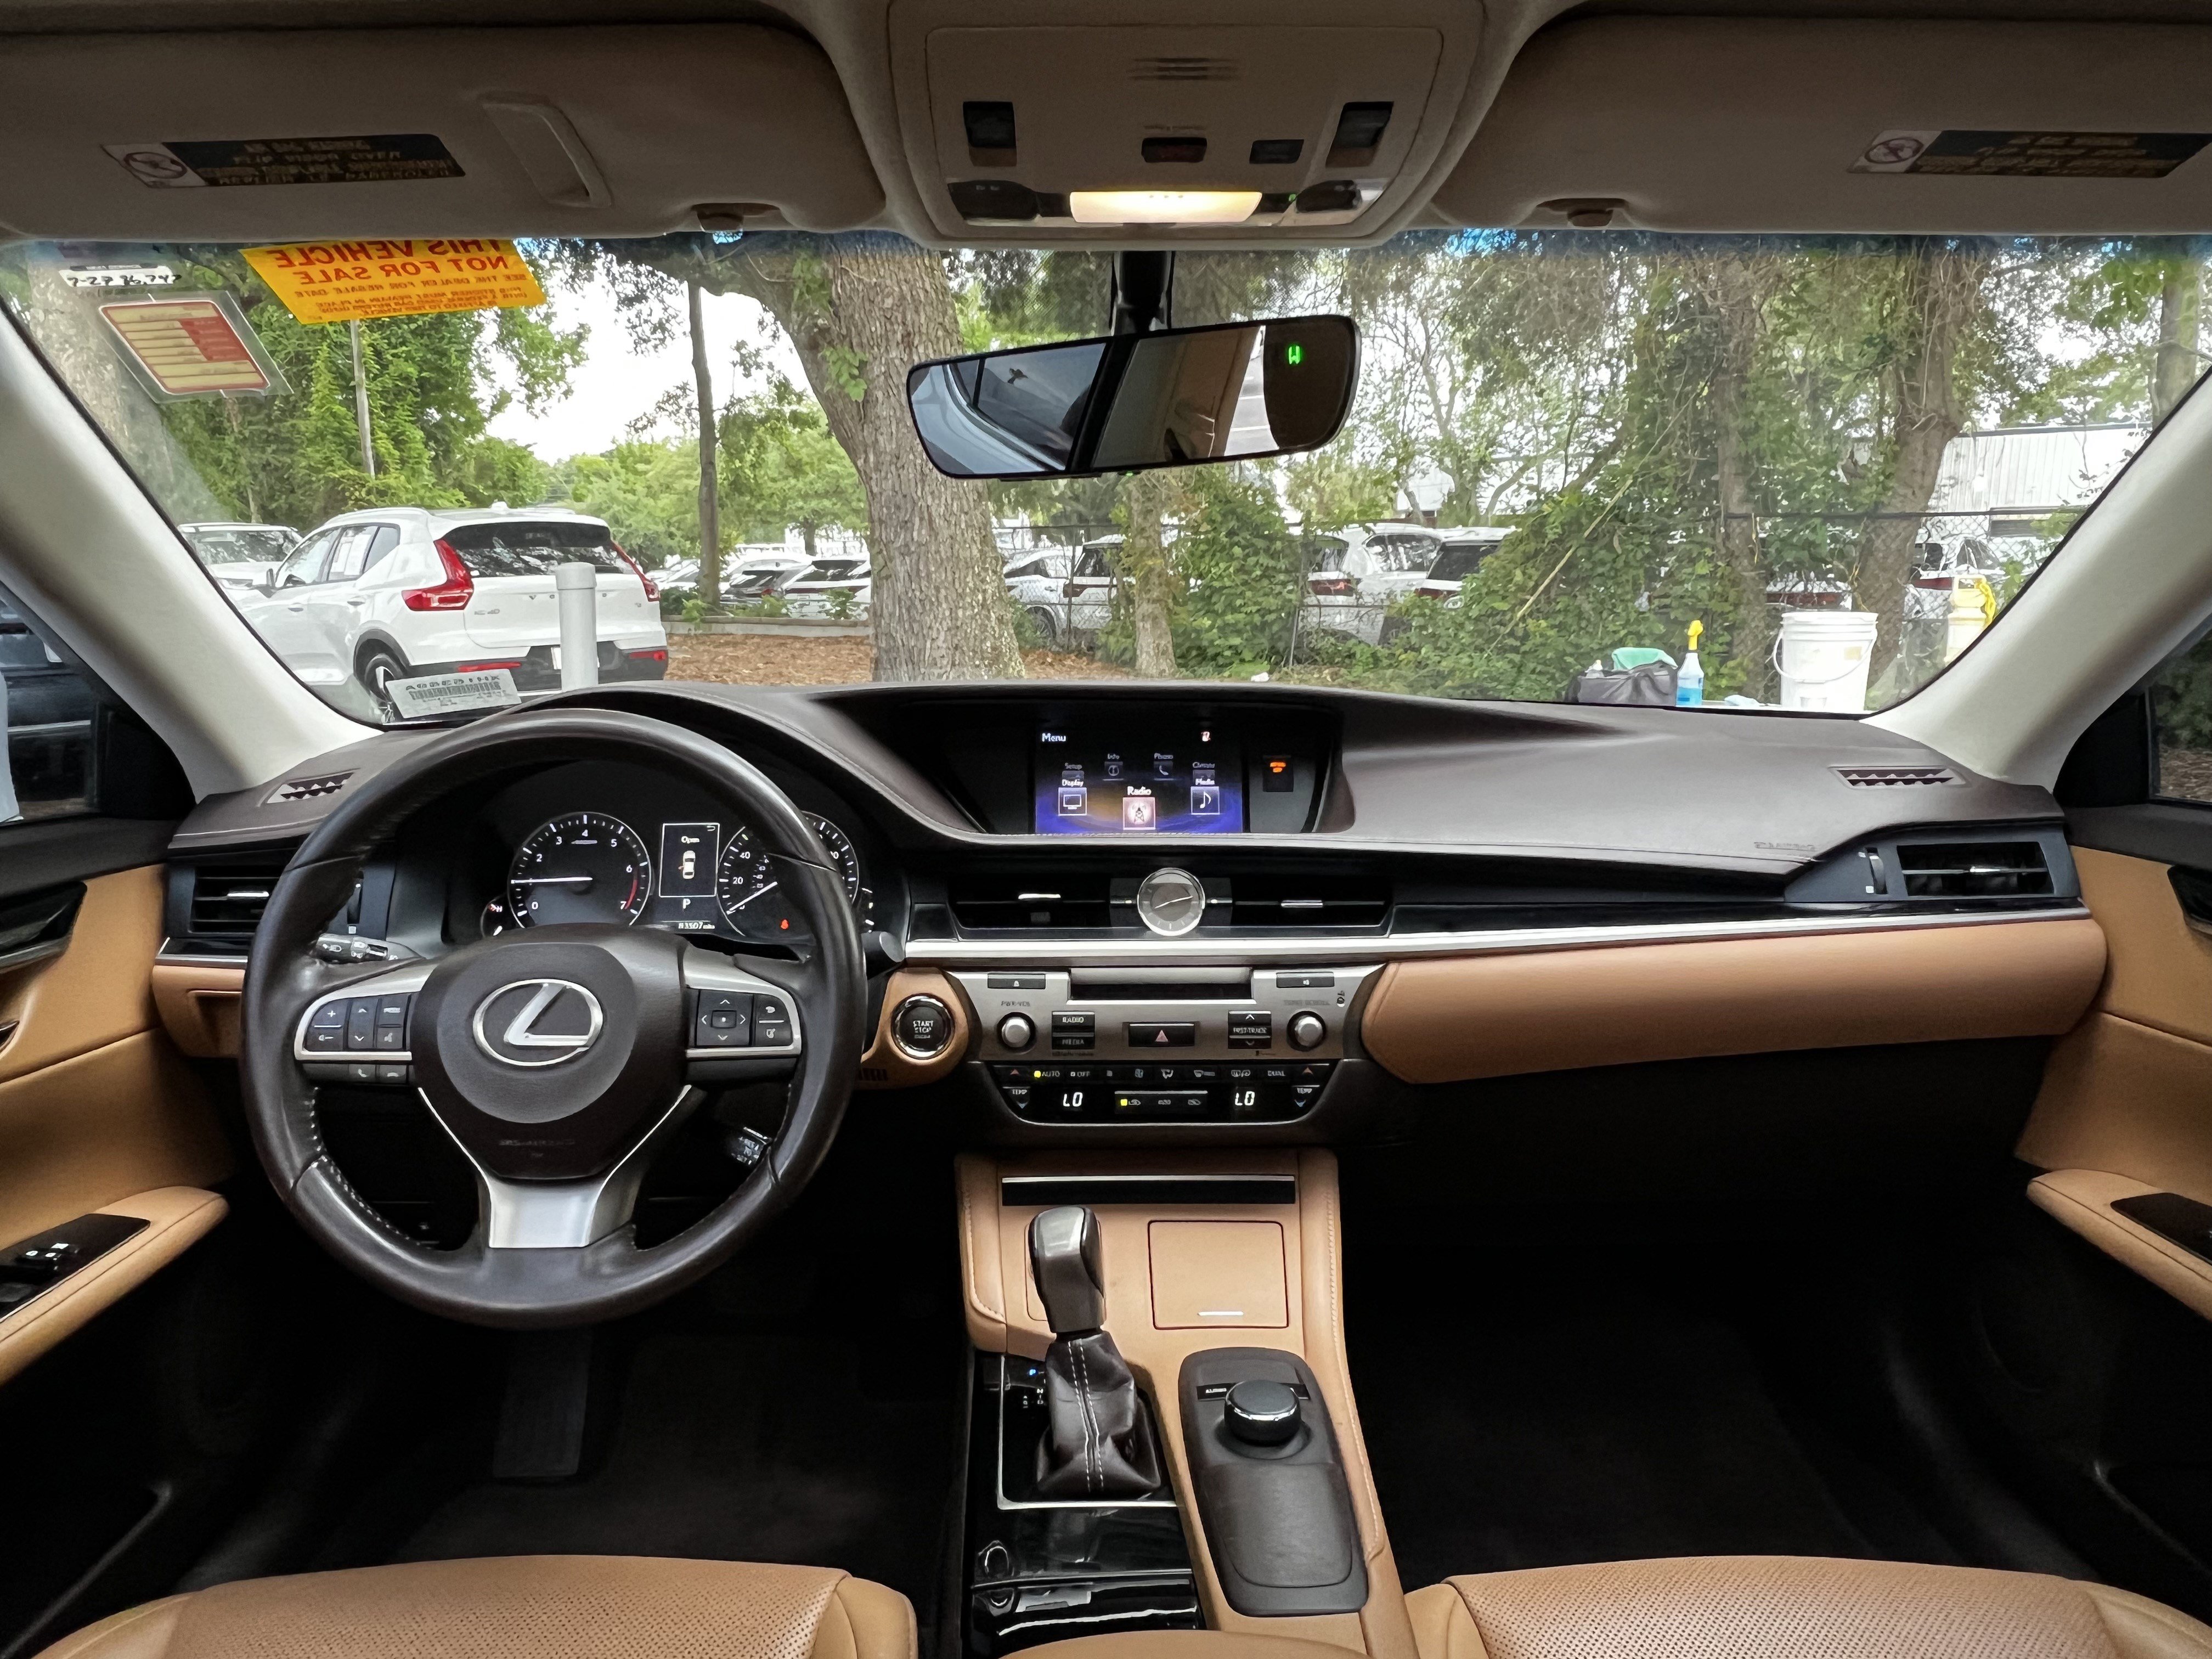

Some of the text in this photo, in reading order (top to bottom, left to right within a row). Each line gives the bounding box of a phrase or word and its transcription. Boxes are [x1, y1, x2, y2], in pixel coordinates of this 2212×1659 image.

[1042, 732, 1066, 742] Menu
[1127, 786, 1152, 796] Radio
[582, 829, 589, 837] 4
[556, 836, 563, 845] 3
[611, 839, 617, 848] 5
[536, 854, 543, 862] 2
[739, 851, 751, 860] 40
[626, 865, 633, 873] 6
[732, 876, 744, 885] 20
[531, 901, 539, 910] 0
[620, 900, 627, 910] 7
[682, 898, 691, 909] P
[1063, 1092, 1083, 1108] LO
[1235, 1091, 1255, 1106] LO
